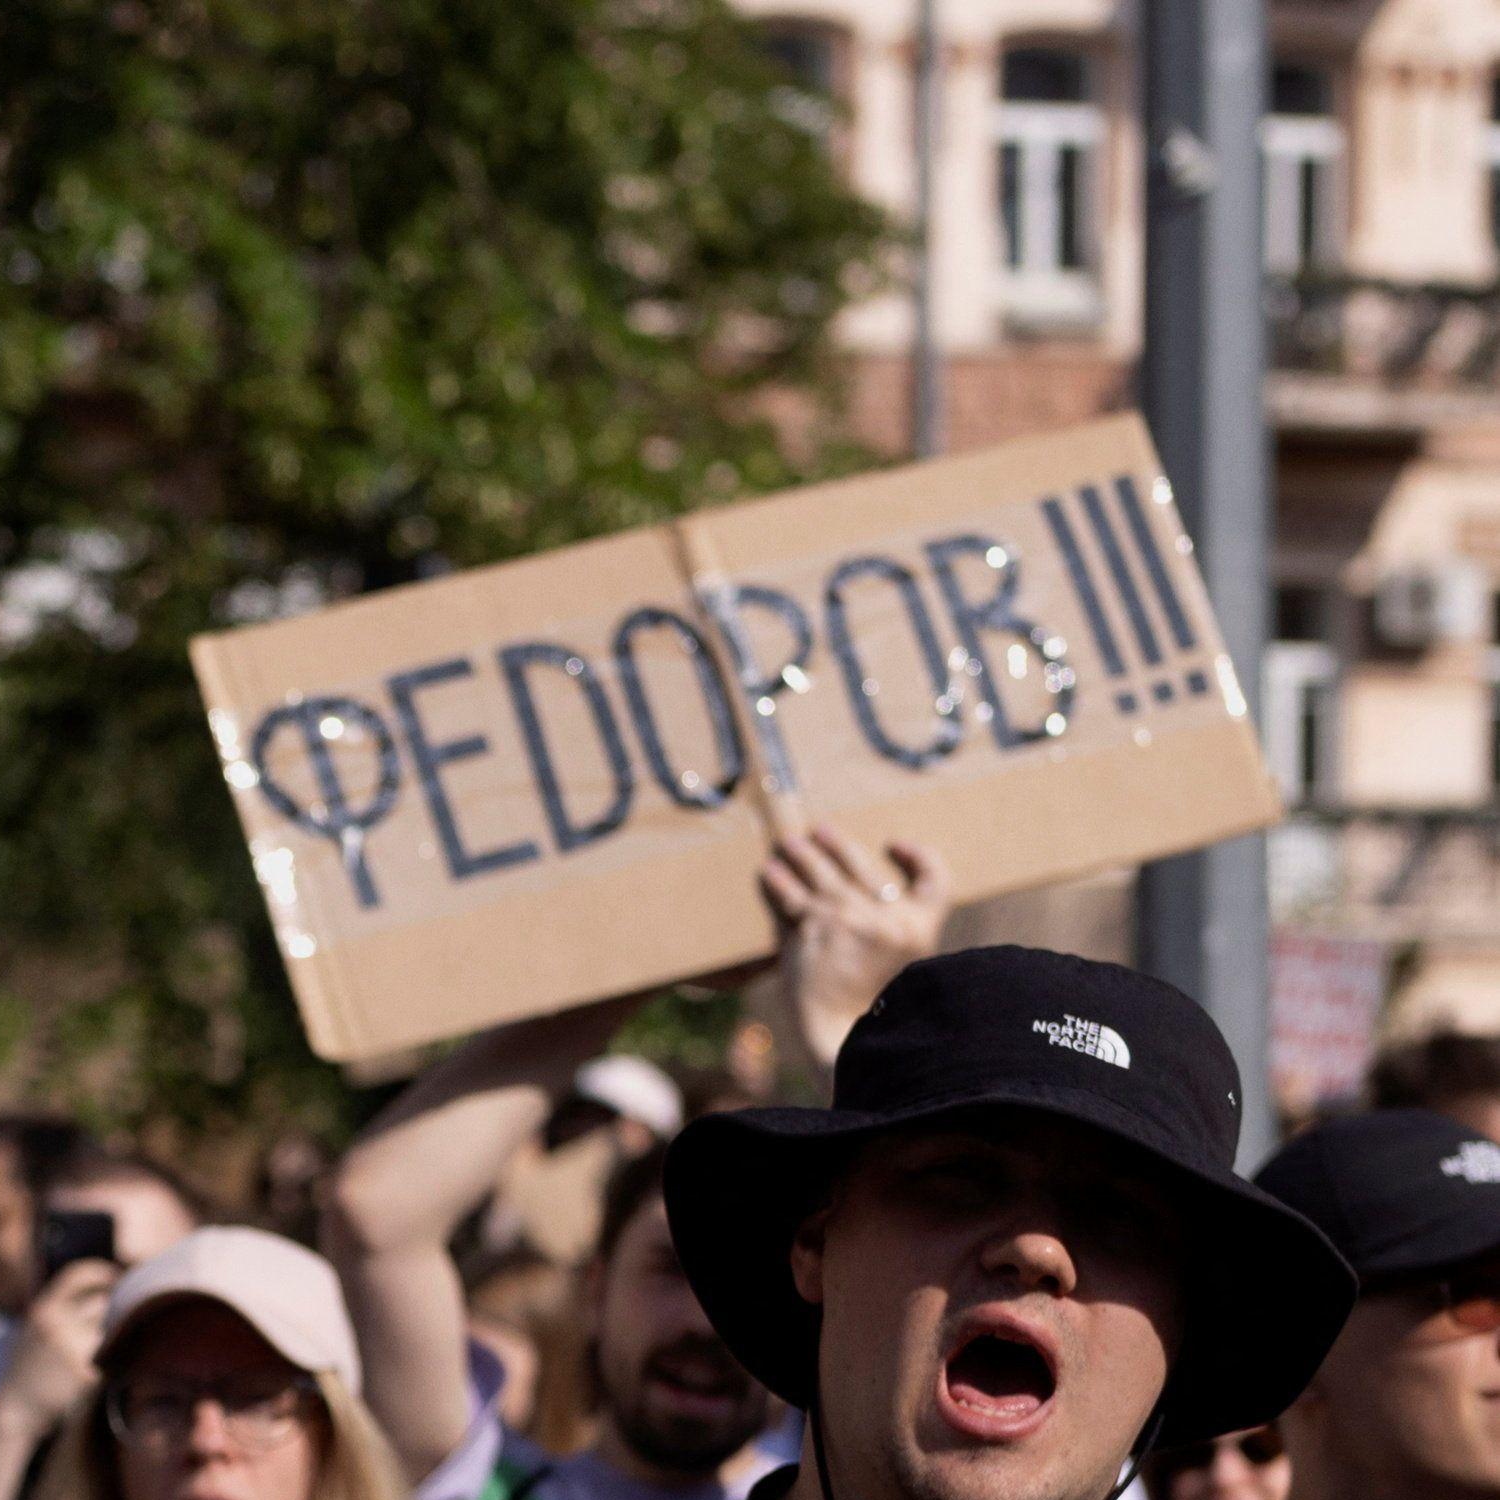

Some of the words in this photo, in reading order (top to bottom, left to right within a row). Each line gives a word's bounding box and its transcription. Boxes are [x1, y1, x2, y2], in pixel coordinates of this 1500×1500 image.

[250, 475, 1209, 909] ФЕДОРОВ!!!
[1032, 1020, 1099, 1048] NORTH
[1064, 1013, 1100, 1035] THE
[1049, 1034, 1096, 1056] FACE
